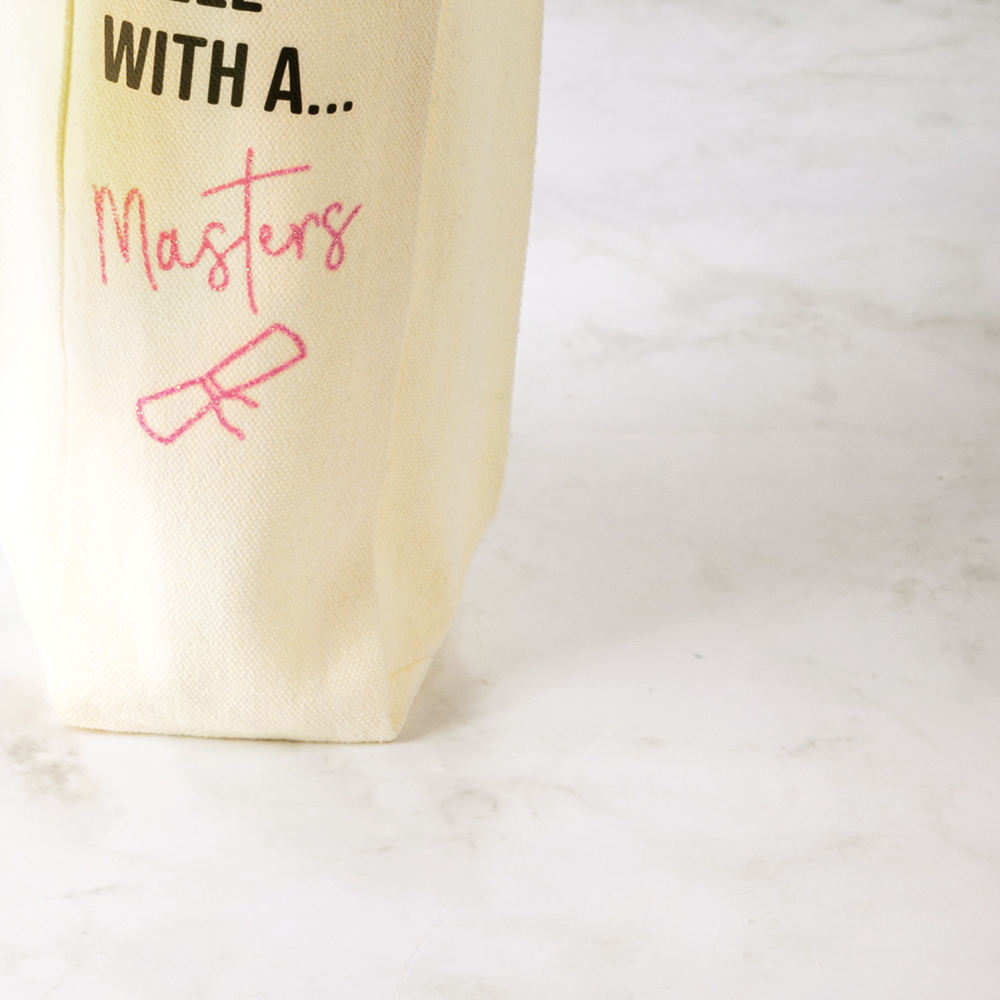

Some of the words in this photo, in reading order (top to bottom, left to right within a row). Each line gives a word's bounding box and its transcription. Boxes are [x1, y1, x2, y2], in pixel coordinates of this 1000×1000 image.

[103, 14, 249, 108] WITH
[263, 46, 354, 116] A...
[93, 147, 362, 314] Masters
